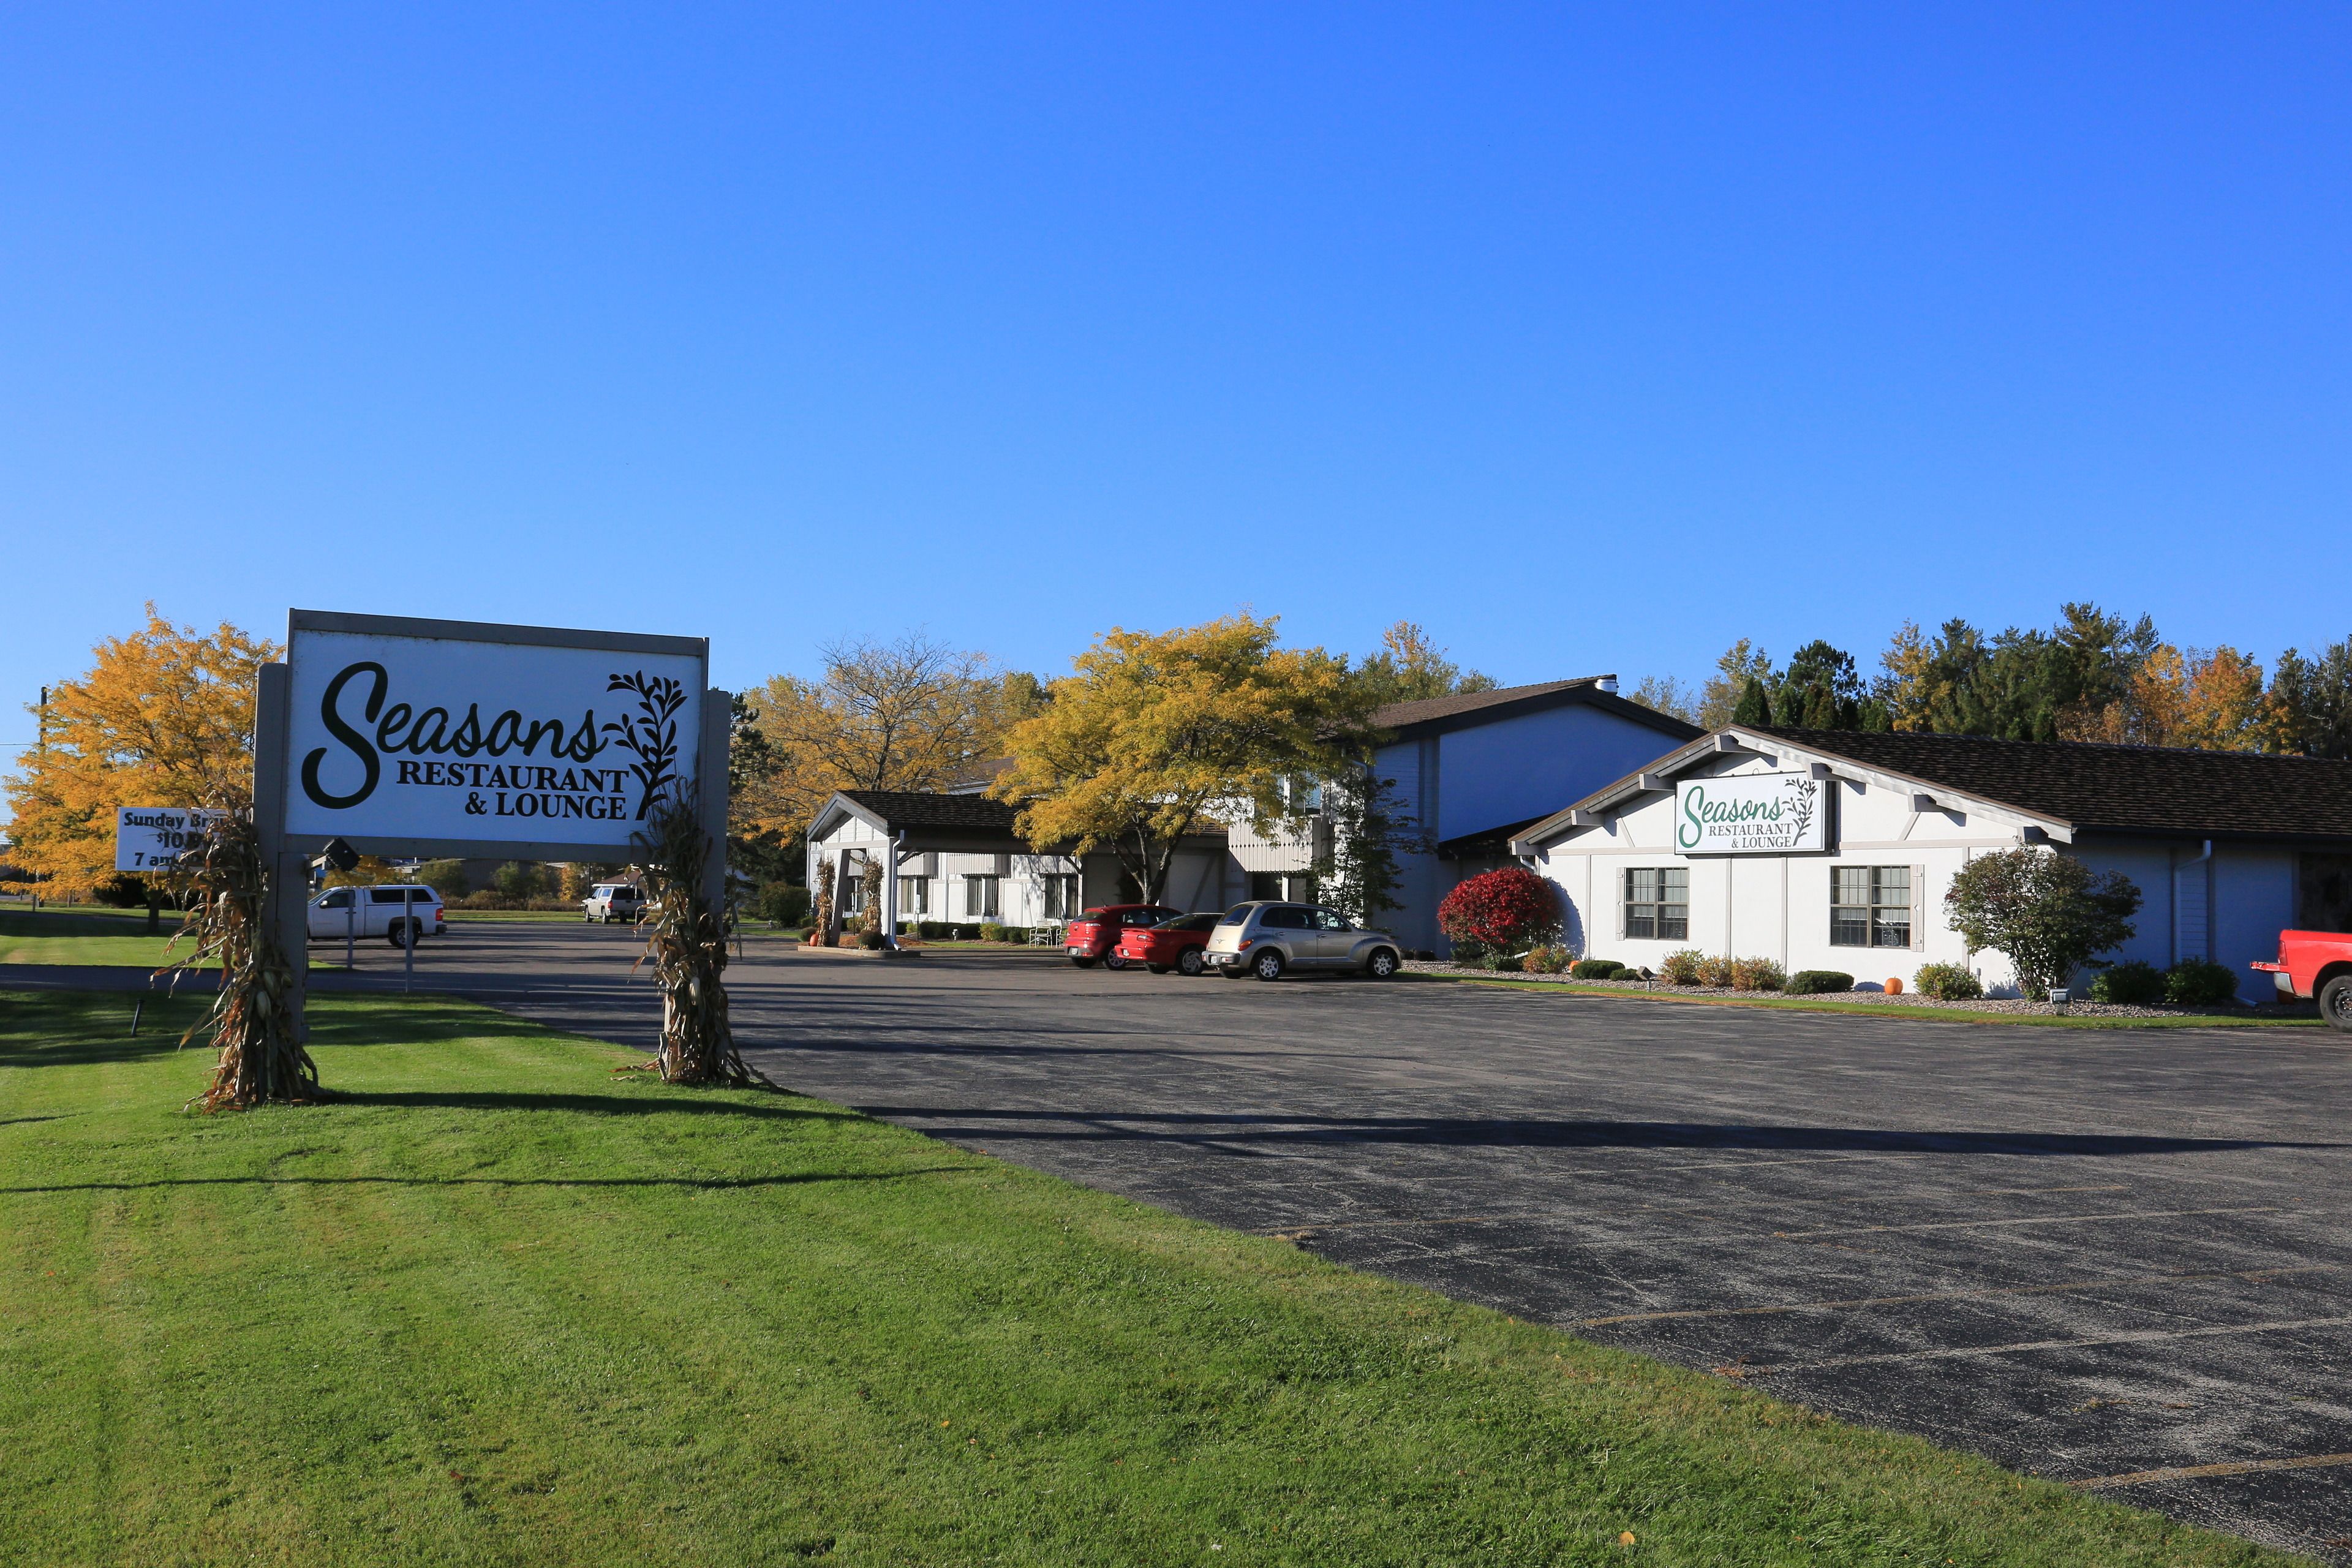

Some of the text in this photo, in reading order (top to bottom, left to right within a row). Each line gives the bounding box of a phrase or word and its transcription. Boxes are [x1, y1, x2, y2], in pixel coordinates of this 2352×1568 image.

[301, 662, 609, 810] Seasons
[396, 760, 630, 794] RESTAURANT
[464, 791, 627, 821] & LOUNGE
[1679, 785, 1785, 848] Seasons
[124, 812, 186, 829] Sunday
[1708, 823, 1793, 837] RESTAURANT
[1732, 837, 1792, 848] & LOUNGE
[134, 852, 145, 866] 7
